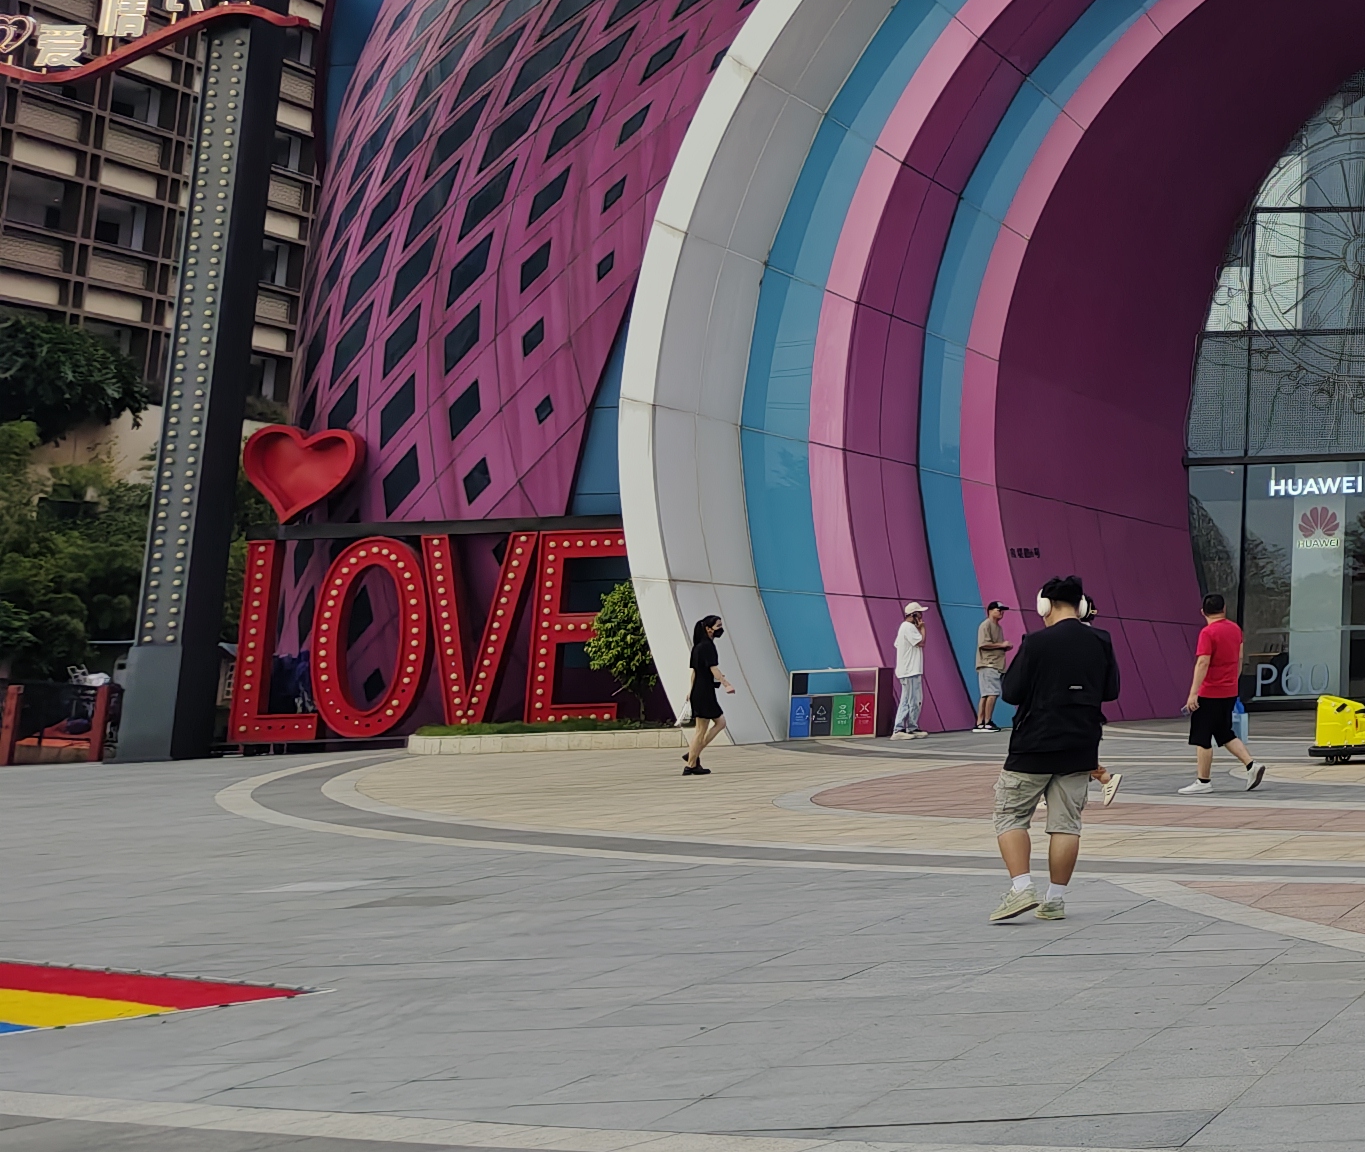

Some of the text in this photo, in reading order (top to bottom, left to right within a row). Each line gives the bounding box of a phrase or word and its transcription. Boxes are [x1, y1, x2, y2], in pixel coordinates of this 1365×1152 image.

[1268, 476, 1364, 497] HUAWEI
[1297, 538, 1340, 549] HUAWEI
[229, 529, 627, 744] LOVE
[1255, 661, 1330, 697] P60
